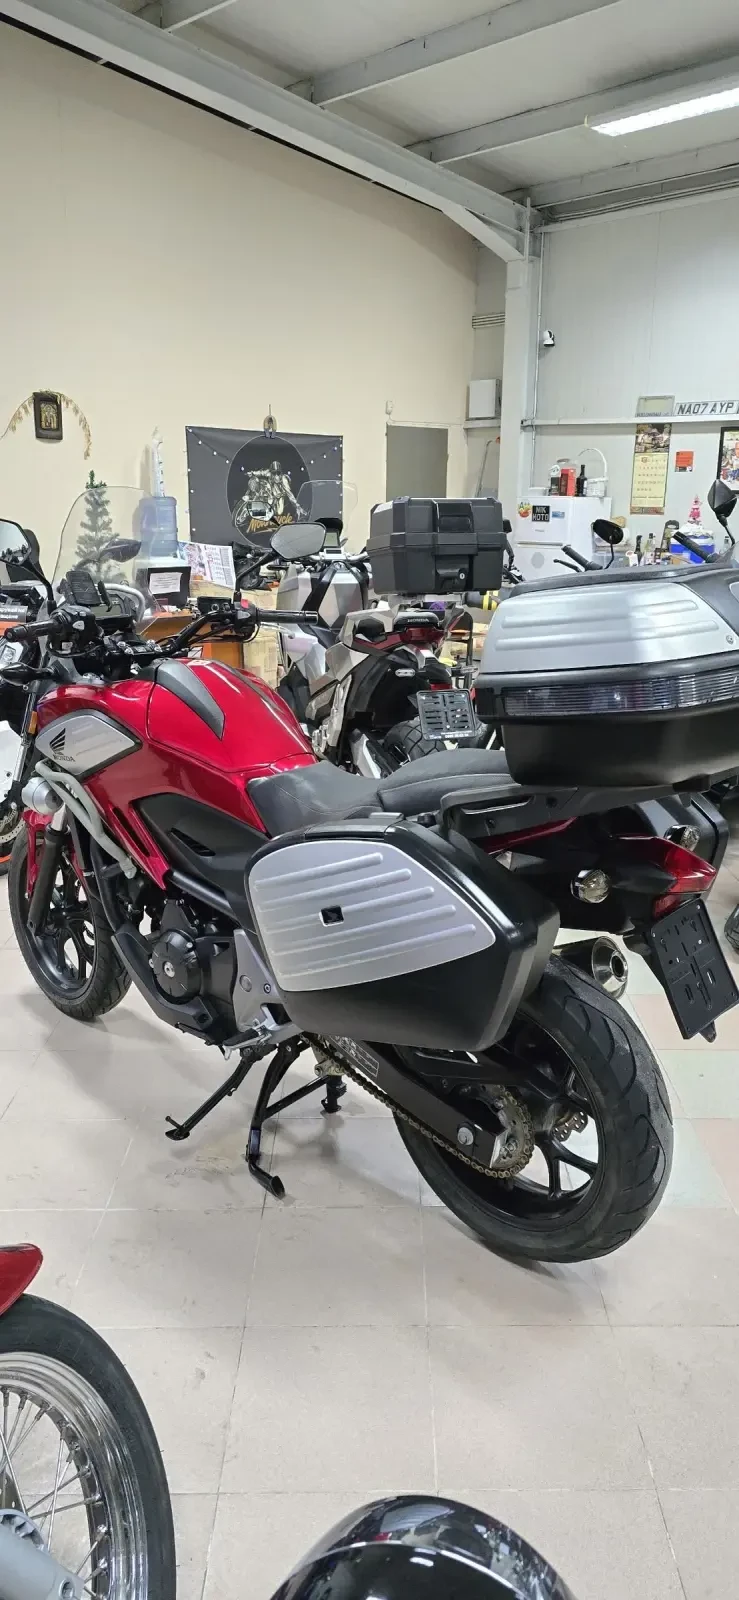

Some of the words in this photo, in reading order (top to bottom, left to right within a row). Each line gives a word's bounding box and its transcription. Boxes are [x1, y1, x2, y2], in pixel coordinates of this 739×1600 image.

[677, 403, 708, 415] NA07
[709, 402, 734, 414] AYP
[535, 506, 547, 514] NIK
[532, 513, 549, 521] MOTO
